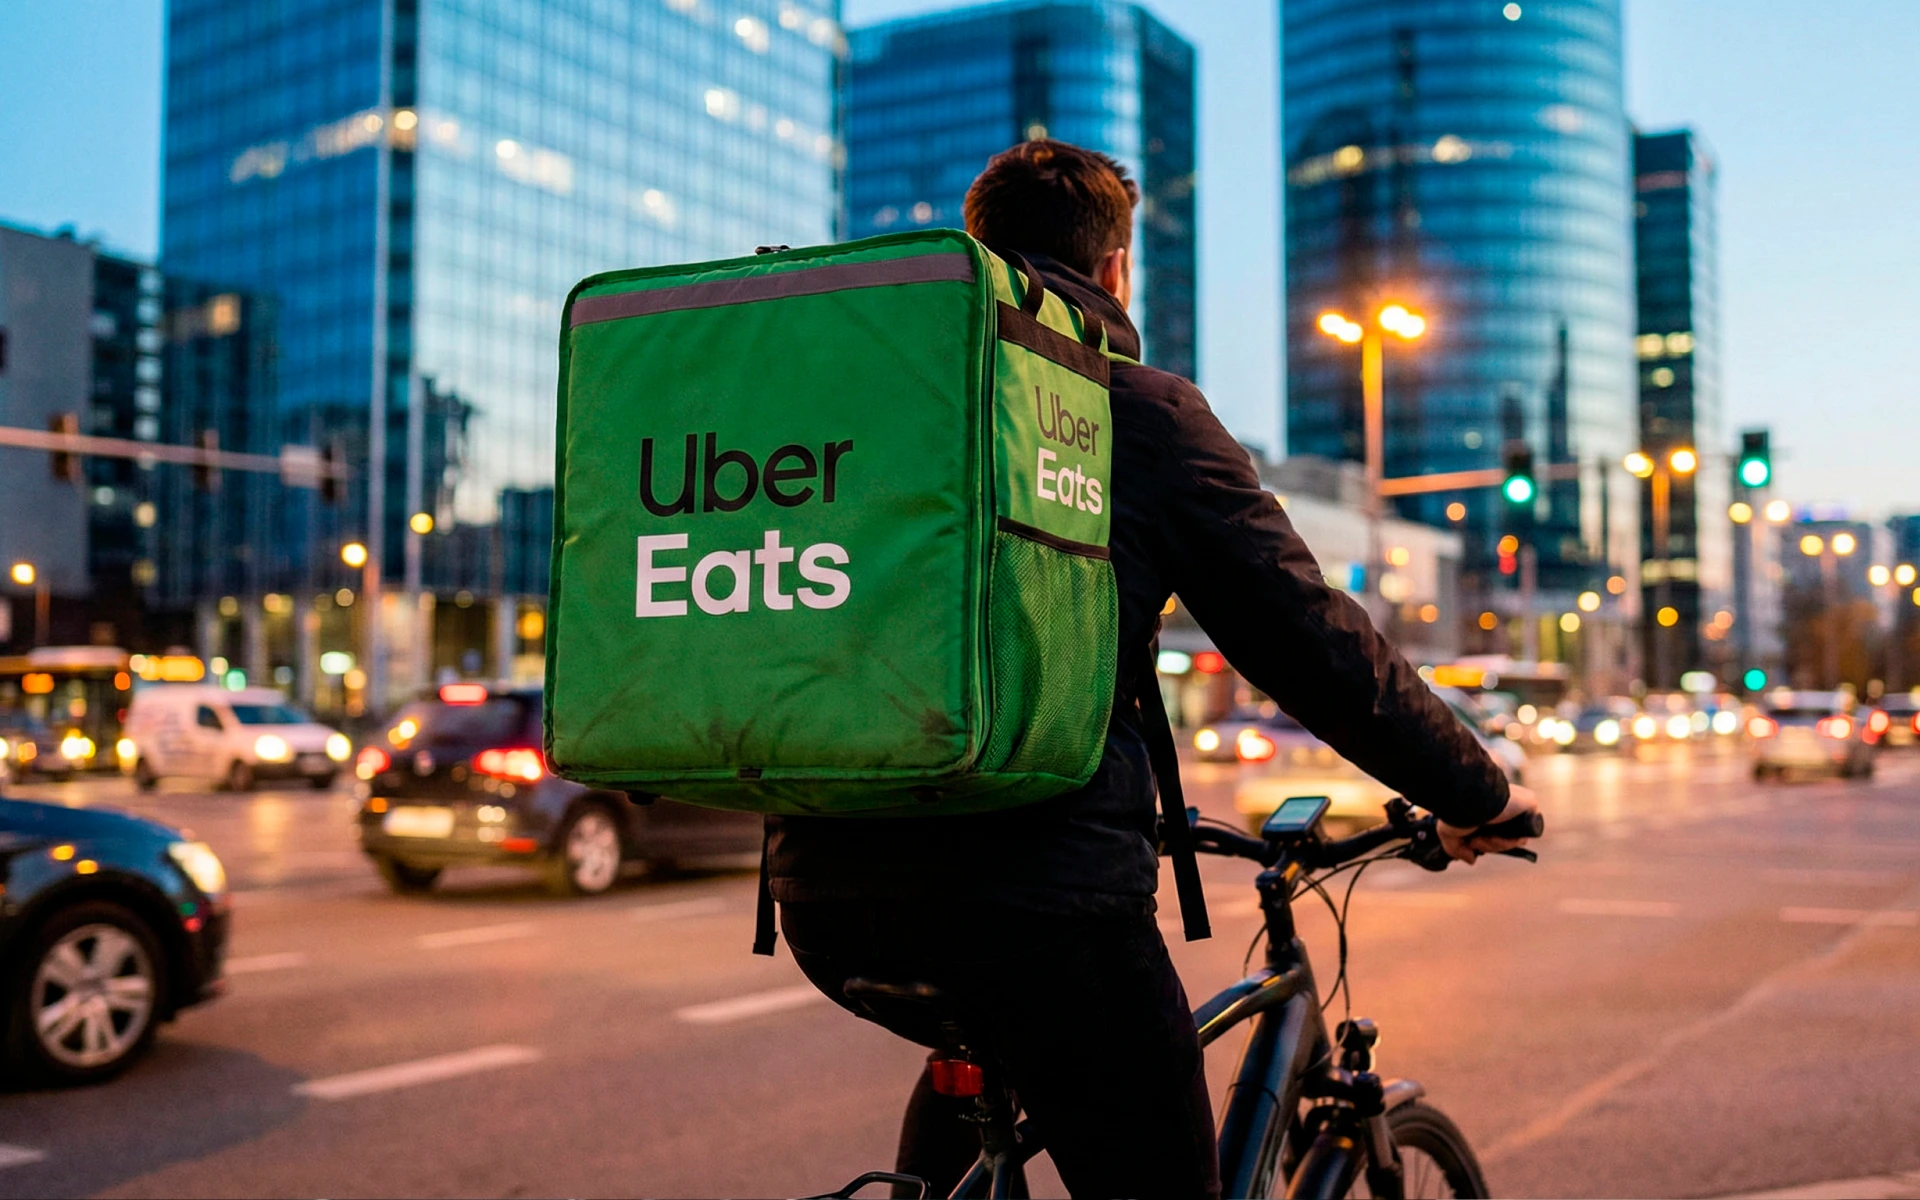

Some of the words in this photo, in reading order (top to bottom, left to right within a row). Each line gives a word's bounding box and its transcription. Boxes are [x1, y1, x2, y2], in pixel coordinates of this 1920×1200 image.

[1035, 385, 1099, 456] Uber
[640, 432, 853, 517] Uber
[1037, 447, 1102, 515] Eats
[635, 530, 851, 617] Eats
